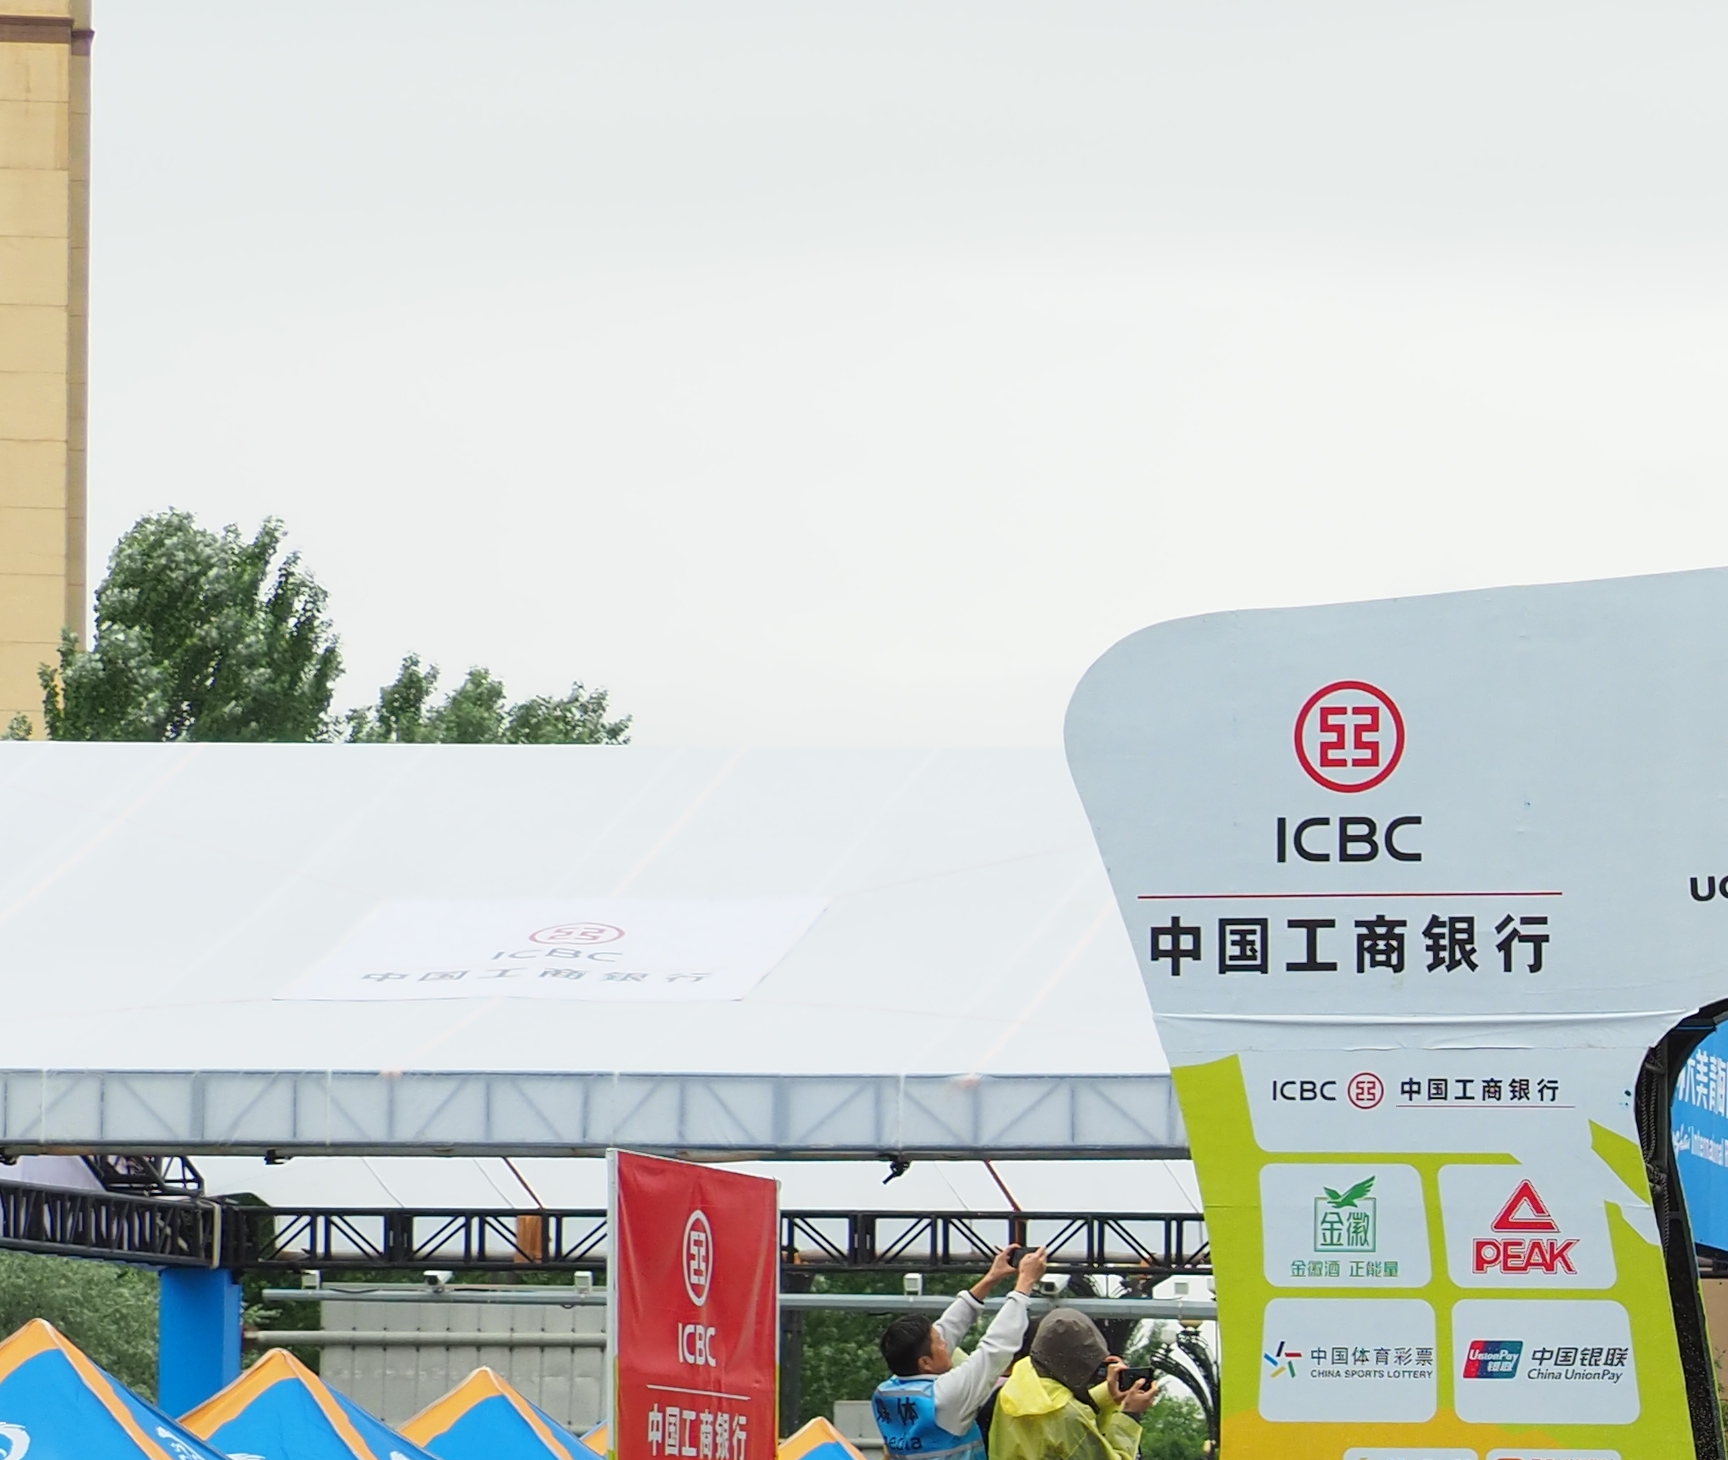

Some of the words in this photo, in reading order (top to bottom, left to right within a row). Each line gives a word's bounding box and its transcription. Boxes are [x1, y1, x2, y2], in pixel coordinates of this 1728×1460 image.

[1276, 816, 1422, 863] ICBC
[491, 947, 623, 963] ICBC
[1149, 914, 1550, 976] 中国工商银行
[360, 966, 714, 985] 中国工商银行
[1272, 1080, 1337, 1101] ICBC
[1401, 1078, 1559, 1102] 中国工商银行
[1320, 1210, 1371, 1248] 金徽
[1472, 1238, 1580, 1275] PEAK
[677, 1322, 717, 1369] ICBC
[1310, 1345, 1434, 1367] 中国体育彩票
[1469, 1350, 1519, 1363] UnionPay
[1531, 1347, 1629, 1368] 中国银联
[1310, 1369, 1341, 1379] CHINA
[1344, 1369, 1384, 1379] SPORTS
[1387, 1369, 1433, 1379] LOTTERY
[1527, 1368, 1562, 1381] China
[1564, 1369, 1623, 1383] UnionPay
